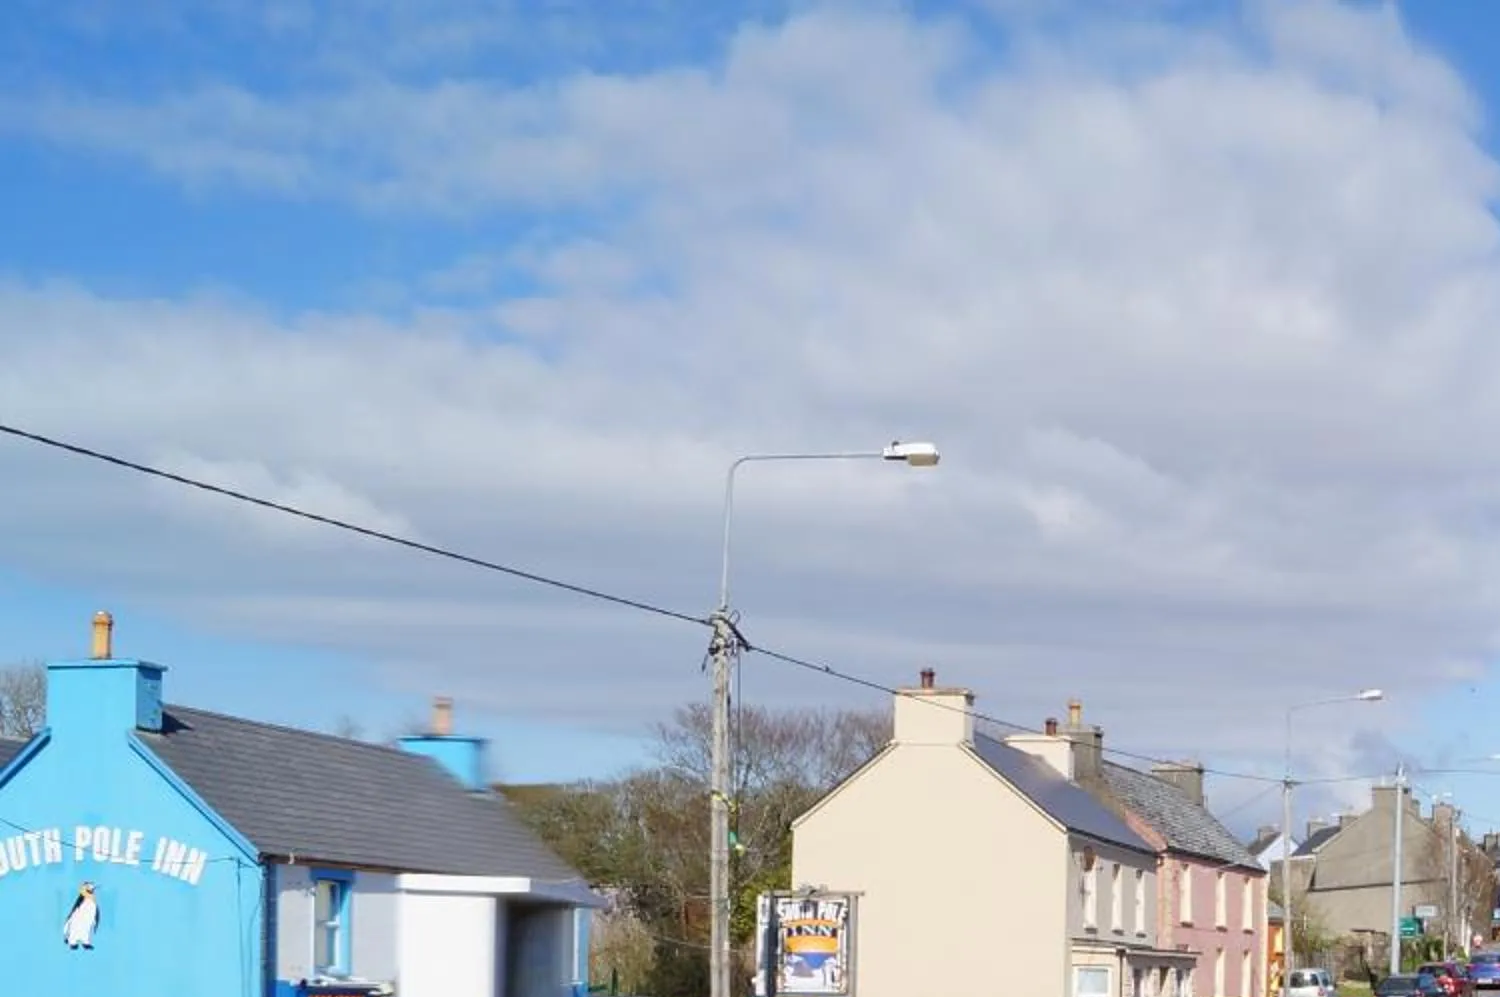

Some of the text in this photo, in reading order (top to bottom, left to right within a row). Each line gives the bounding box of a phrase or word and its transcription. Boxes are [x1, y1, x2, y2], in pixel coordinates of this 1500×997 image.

[75, 825, 144, 865] POLE
[152, 837, 207, 886] INN
[791, 925, 833, 937] INN
